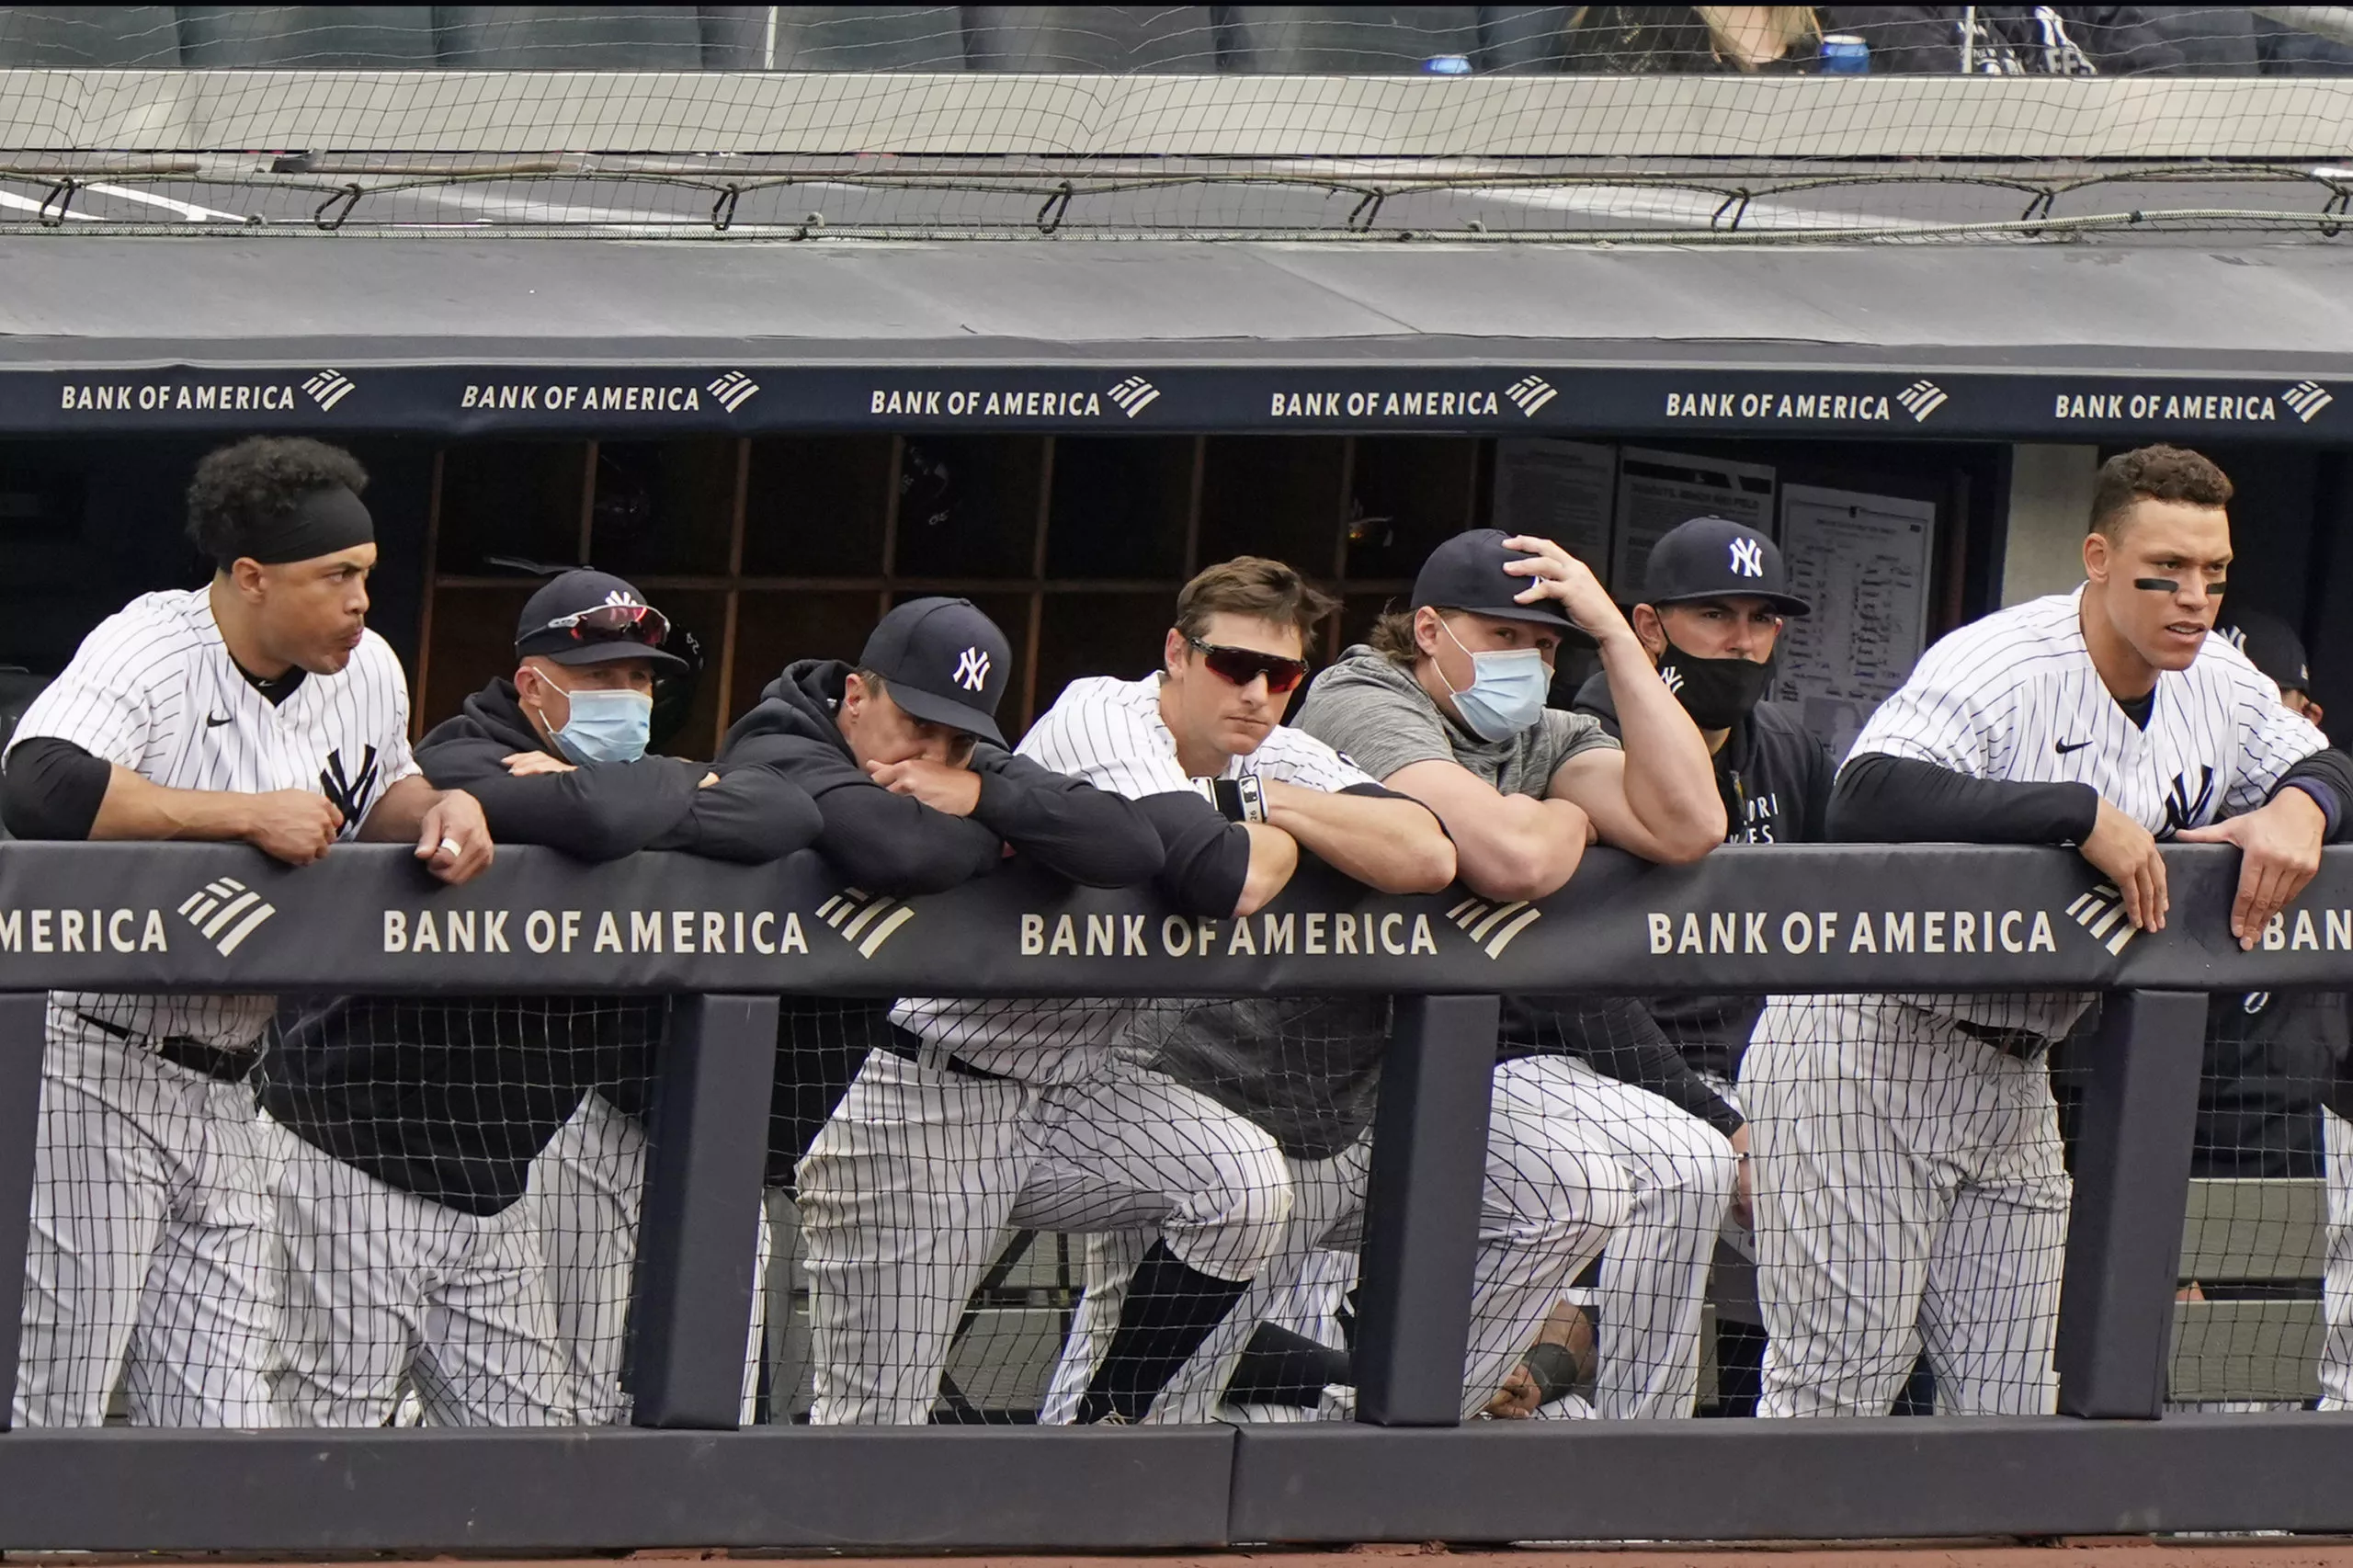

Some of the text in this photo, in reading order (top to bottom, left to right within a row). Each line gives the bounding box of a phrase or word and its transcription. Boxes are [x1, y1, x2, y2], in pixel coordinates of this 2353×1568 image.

[61, 385, 294, 410] BANK OF AMERICA
[460, 385, 699, 412] BANK OF AMERICA
[870, 390, 1100, 416] BANK OF AMERICA
[1270, 391, 1498, 416] BANK OF AMERICA
[1665, 392, 1890, 421] BANK OF AMERICA
[2055, 394, 2276, 421] BANK OF AMERICA
[1729, 537, 1763, 577] NY
[952, 646, 991, 691] NY
[0, 908, 167, 953] MERICA
[383, 909, 809, 955] BANK OF AMERICA
[1020, 913, 1438, 957] BANK OF AMERICA
[1647, 910, 2057, 955] BANK OF AMERICA
[2263, 909, 2352, 951] BAN
